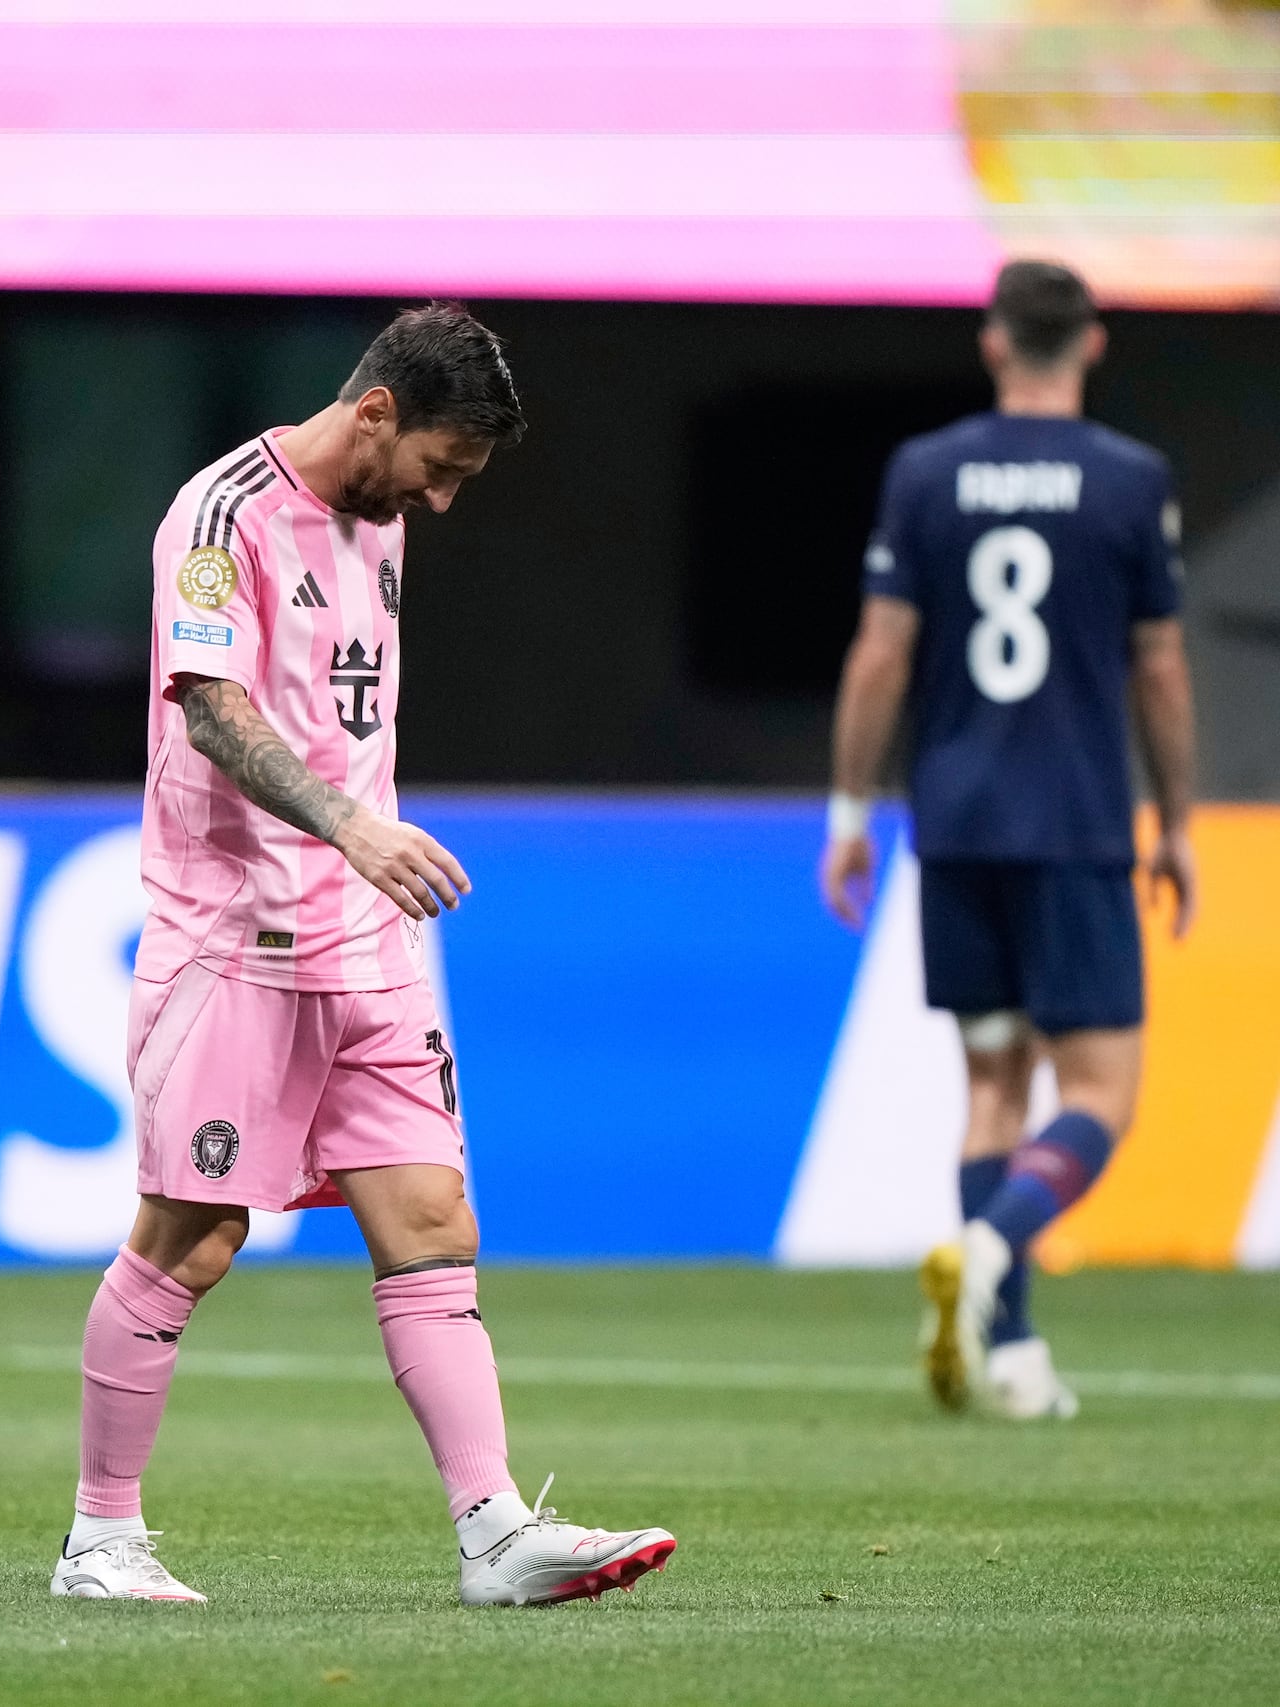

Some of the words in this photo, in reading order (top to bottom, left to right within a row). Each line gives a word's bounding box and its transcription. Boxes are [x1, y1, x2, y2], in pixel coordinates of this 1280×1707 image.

[185, 552, 213, 570] WORLD
[215, 554, 229, 568] CUP
[182, 572, 192, 592] CLUB
[193, 593, 217, 606] FIFA
[967, 525, 1053, 704] 8
